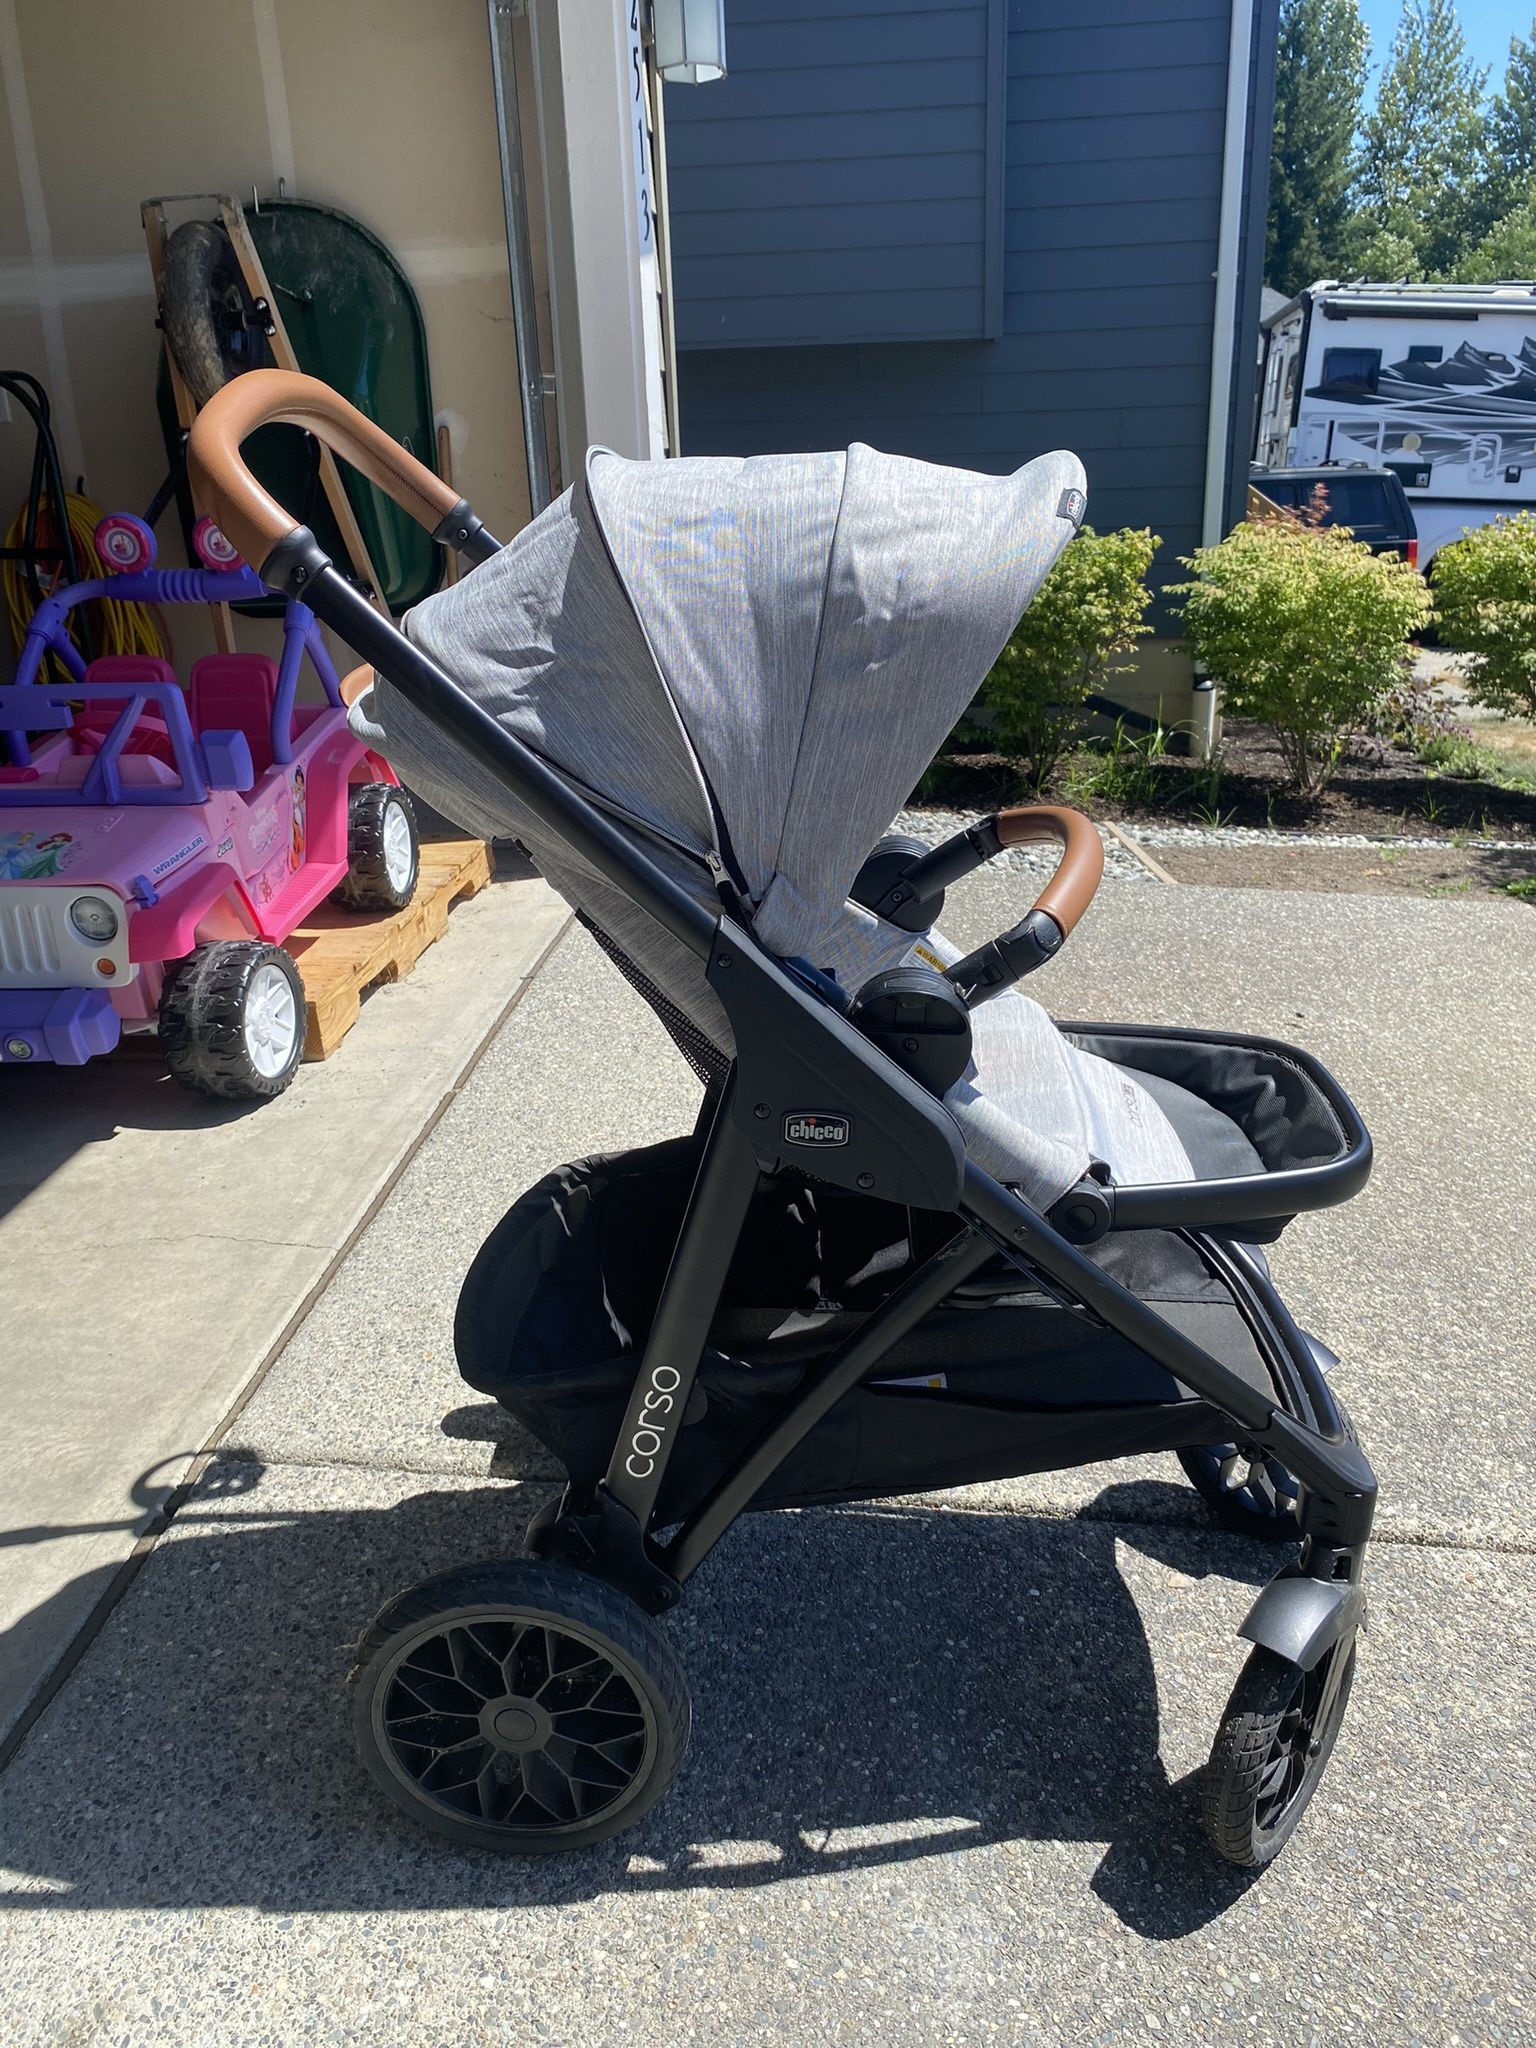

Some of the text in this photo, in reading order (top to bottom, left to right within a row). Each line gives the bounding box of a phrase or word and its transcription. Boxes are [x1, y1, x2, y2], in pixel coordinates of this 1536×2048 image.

[153, 836, 204, 875] WRANGLER
[790, 1116, 844, 1141] chicco
[625, 1365, 681, 1478] corso
